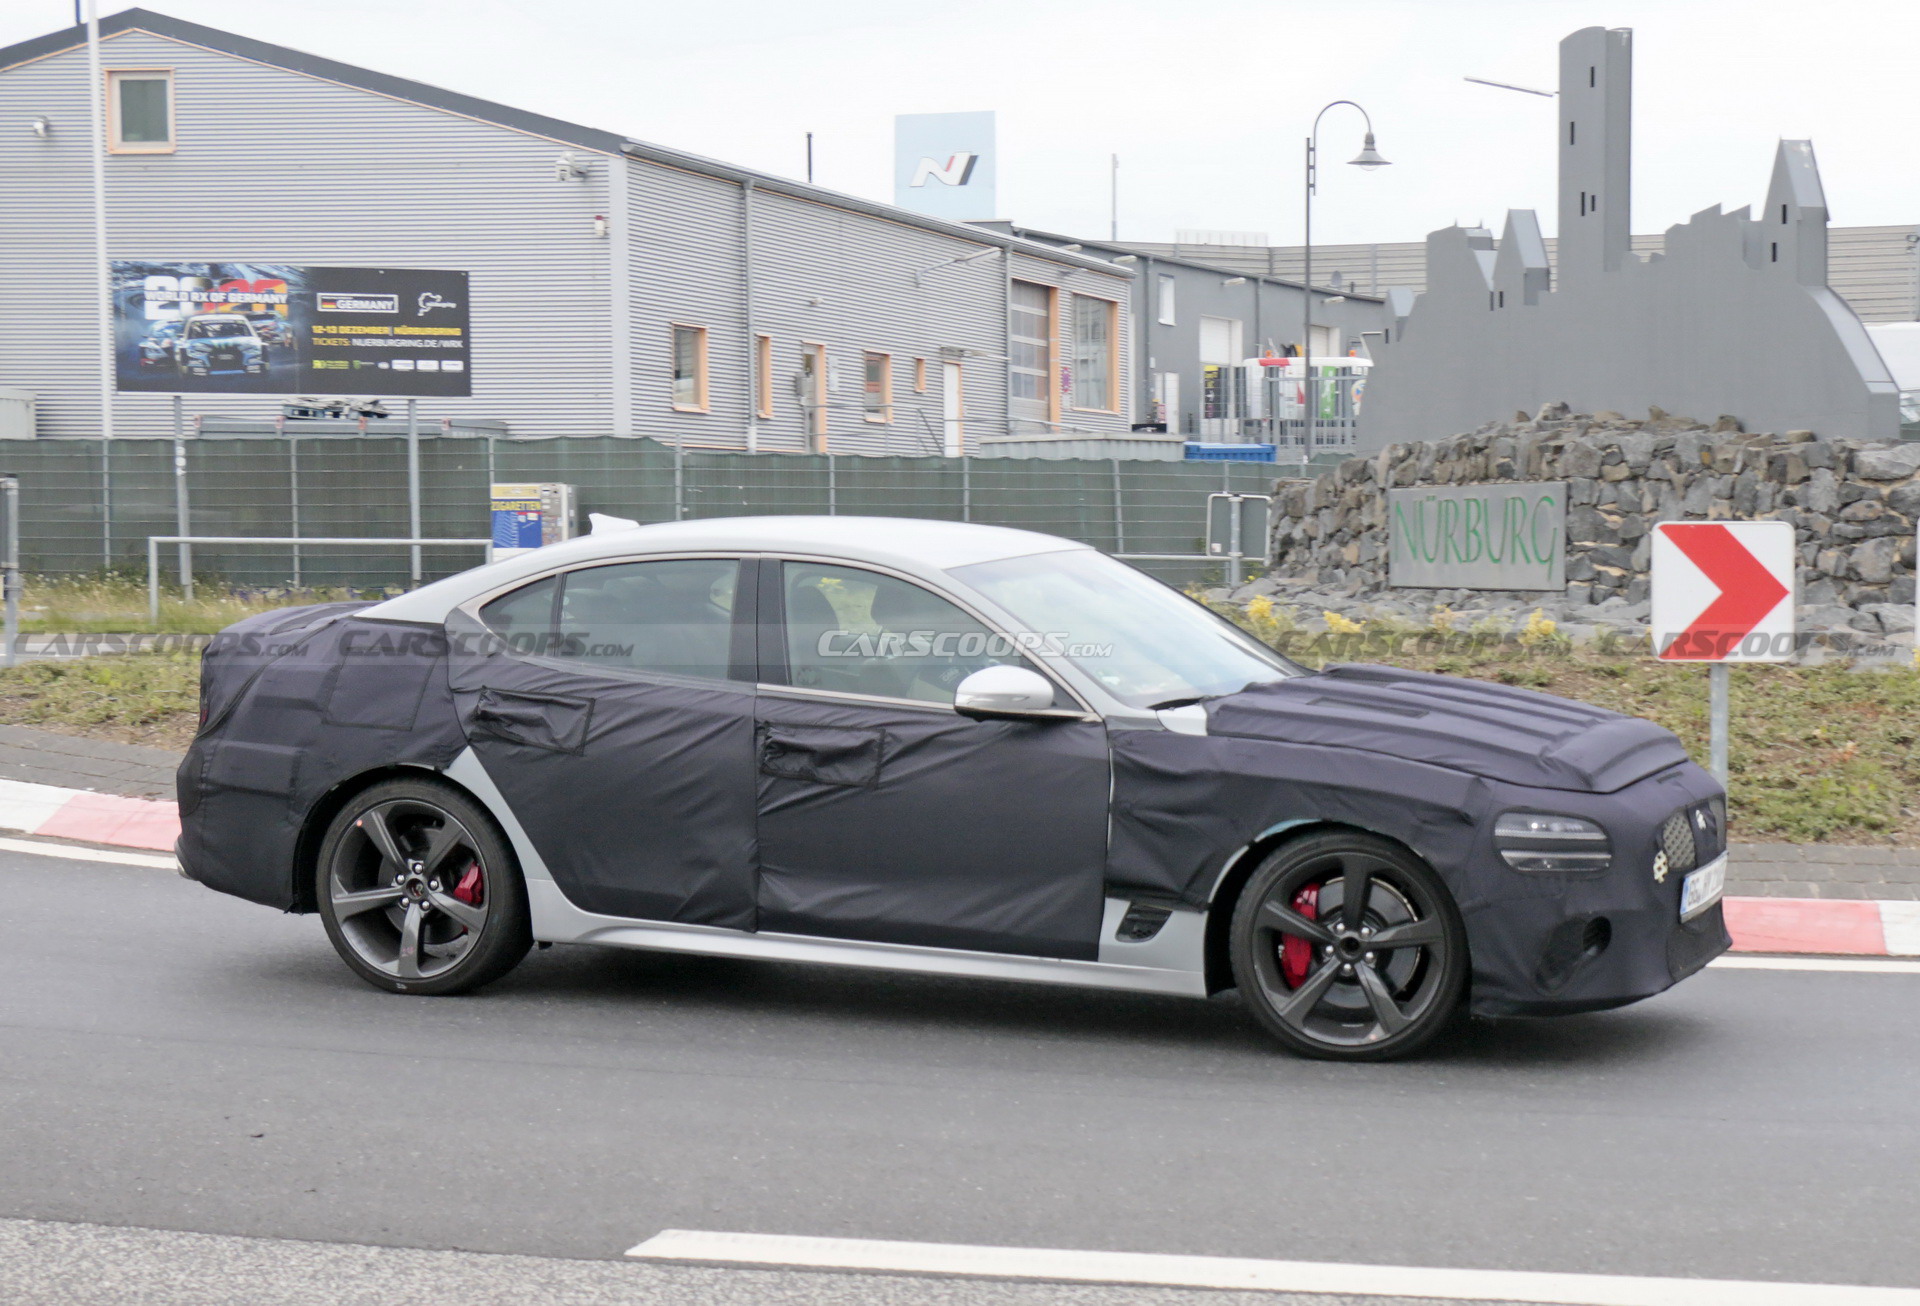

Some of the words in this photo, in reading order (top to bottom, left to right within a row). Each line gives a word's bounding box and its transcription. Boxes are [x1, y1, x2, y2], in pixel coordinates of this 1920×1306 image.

[144, 290, 189, 301] WORLD
[190, 292, 209, 302] RX
[209, 292, 227, 302] OF
[228, 293, 289, 304] GERMANY
[336, 299, 394, 310] GERMANY
[311, 337, 351, 346] TICKETS:
[1394, 495, 1558, 582] NÜRBURG
